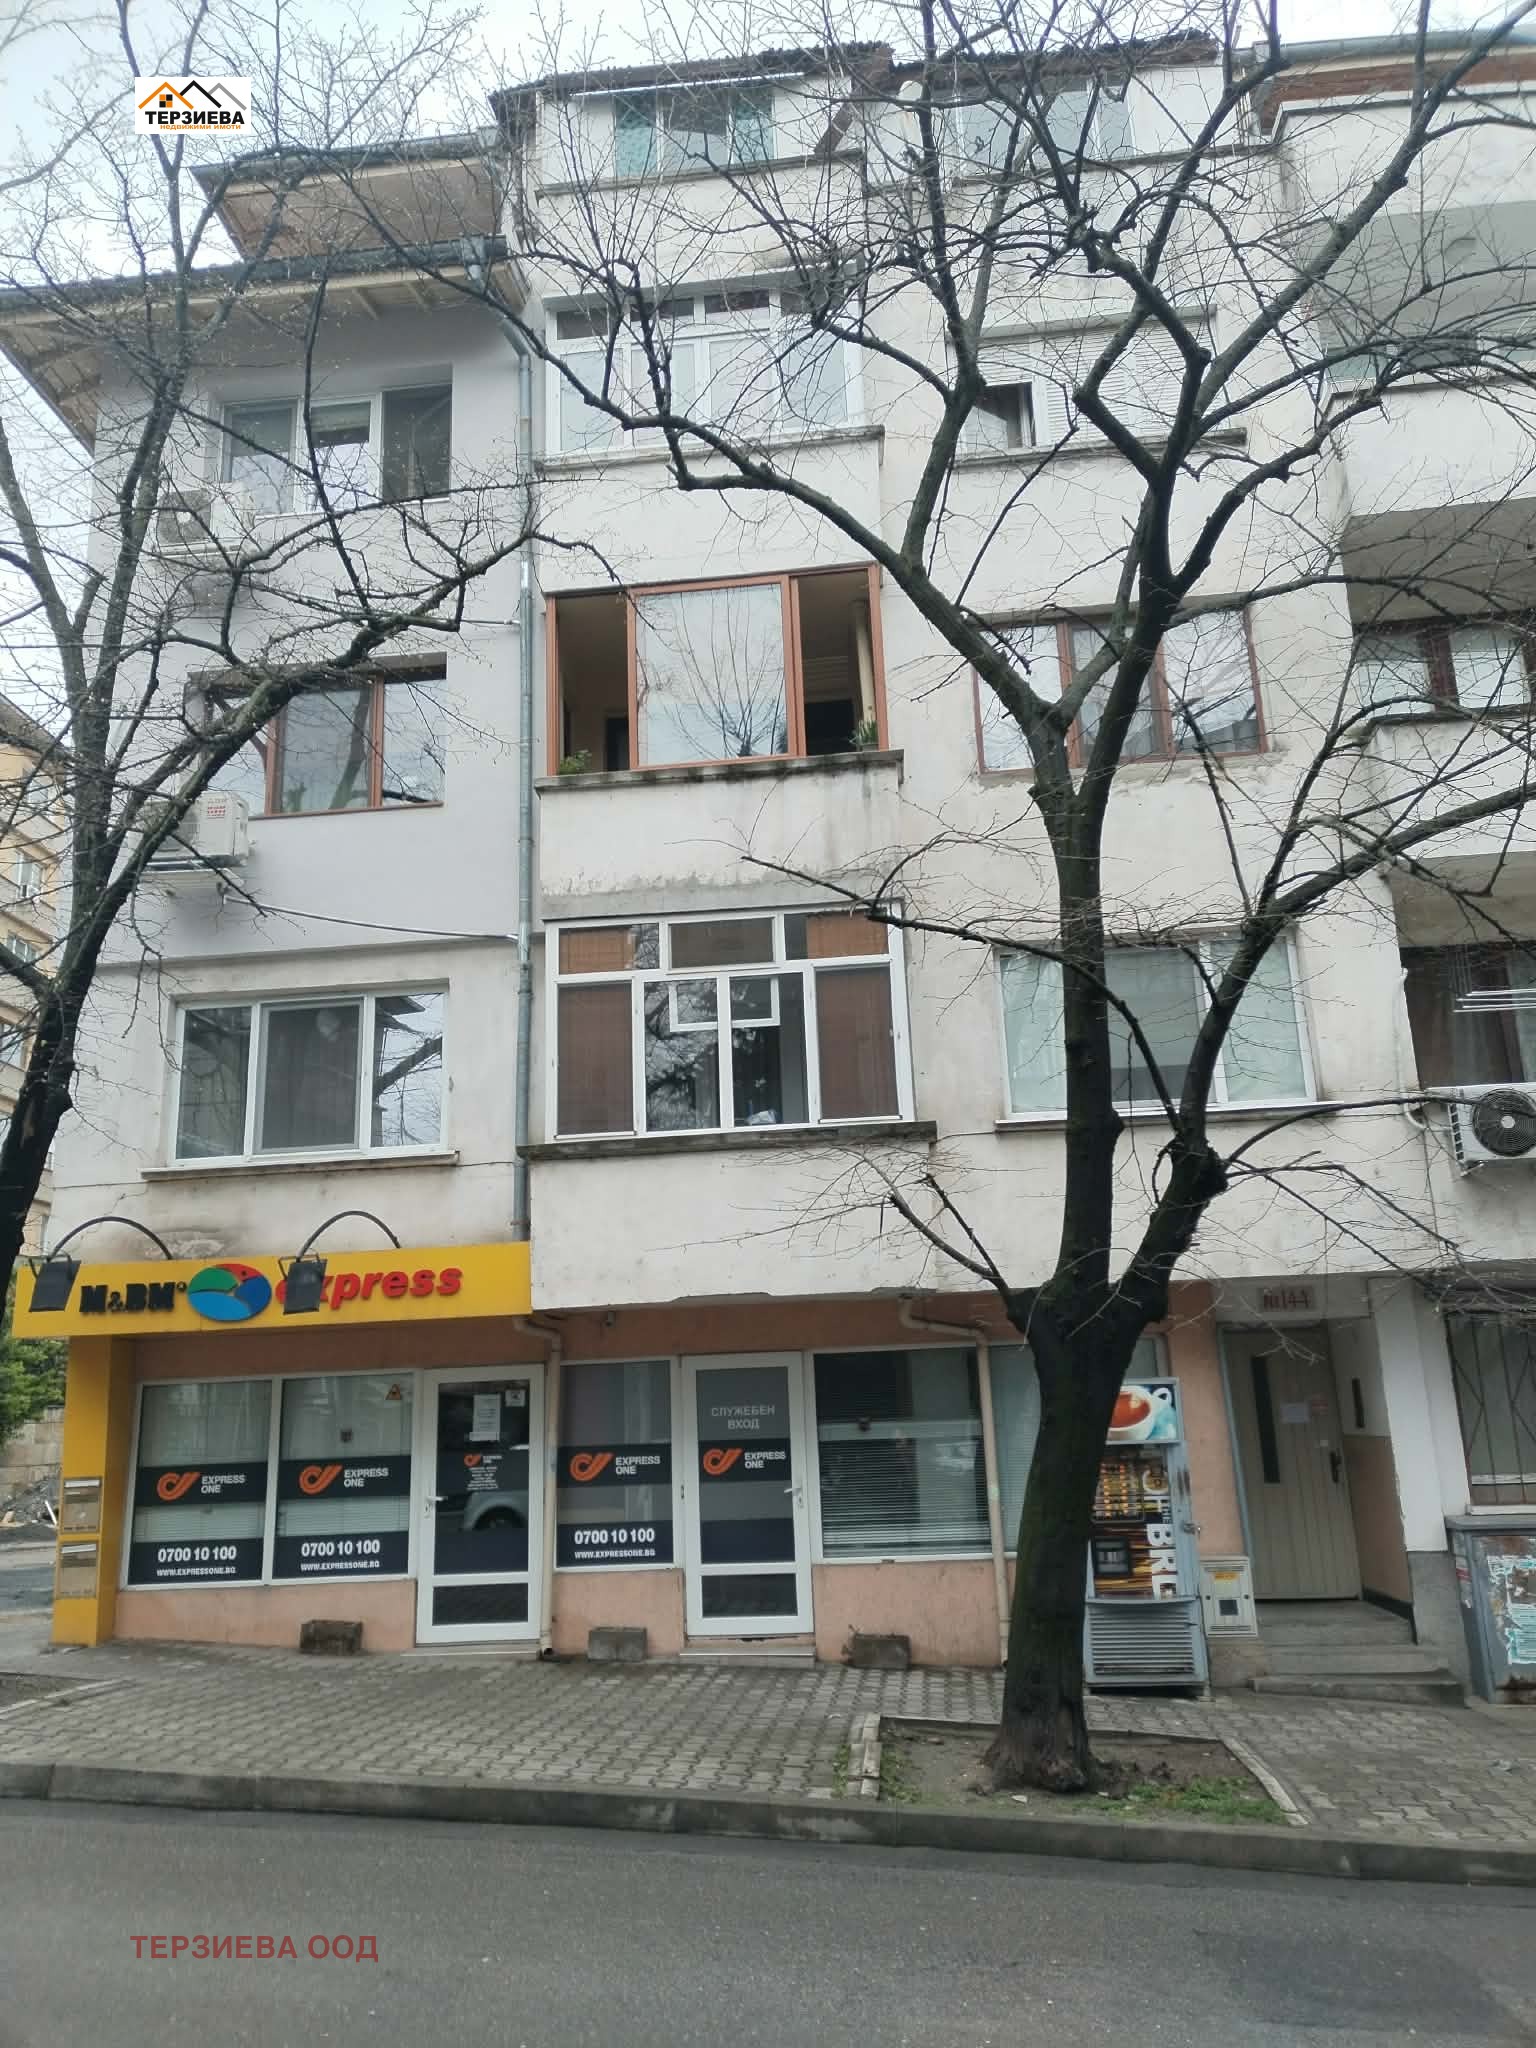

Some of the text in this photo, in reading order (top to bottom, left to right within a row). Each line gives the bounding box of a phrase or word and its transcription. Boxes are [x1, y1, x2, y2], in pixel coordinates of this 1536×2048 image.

[711, 1404, 776, 1417] СЛУЖЕБЕН
[727, 1418, 760, 1430] ВХОД
[615, 1456, 661, 1466] EXPRESS
[744, 1451, 787, 1461] EXPRESS
[615, 1465, 637, 1475] ONE
[744, 1460, 765, 1469] ONE
[343, 1467, 389, 1478] EXPRESS
[201, 1474, 246, 1485] EXPRESS
[343, 1478, 365, 1488] ONE
[200, 1485, 222, 1494] ONE
[574, 1527, 656, 1545] 0700 10 100
[157, 1545, 238, 1562] 0700 10 100
[301, 1539, 381, 1557] 0700 10 100
